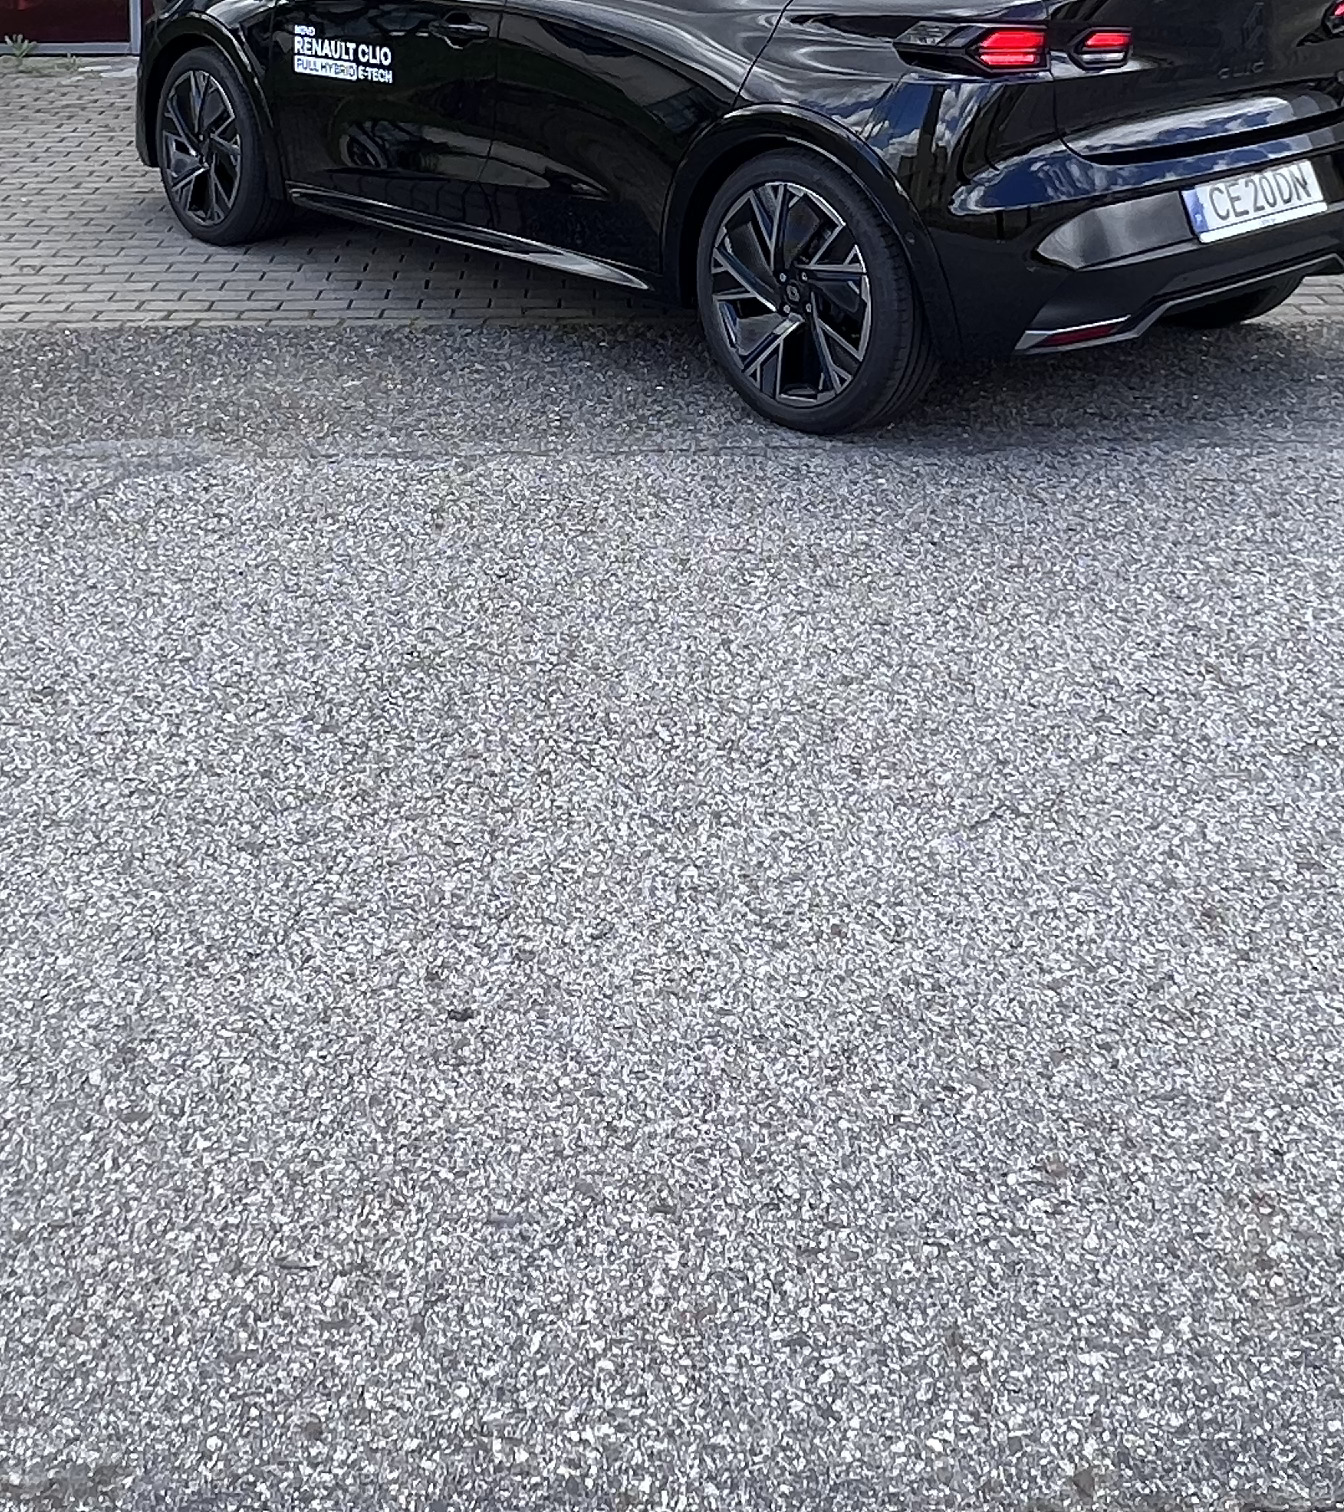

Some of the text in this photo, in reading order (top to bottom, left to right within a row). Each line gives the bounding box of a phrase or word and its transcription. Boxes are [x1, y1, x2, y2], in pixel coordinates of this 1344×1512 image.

[295, 36, 391, 66] RENAULT CLIO
[358, 66, 393, 83] E-TECH
